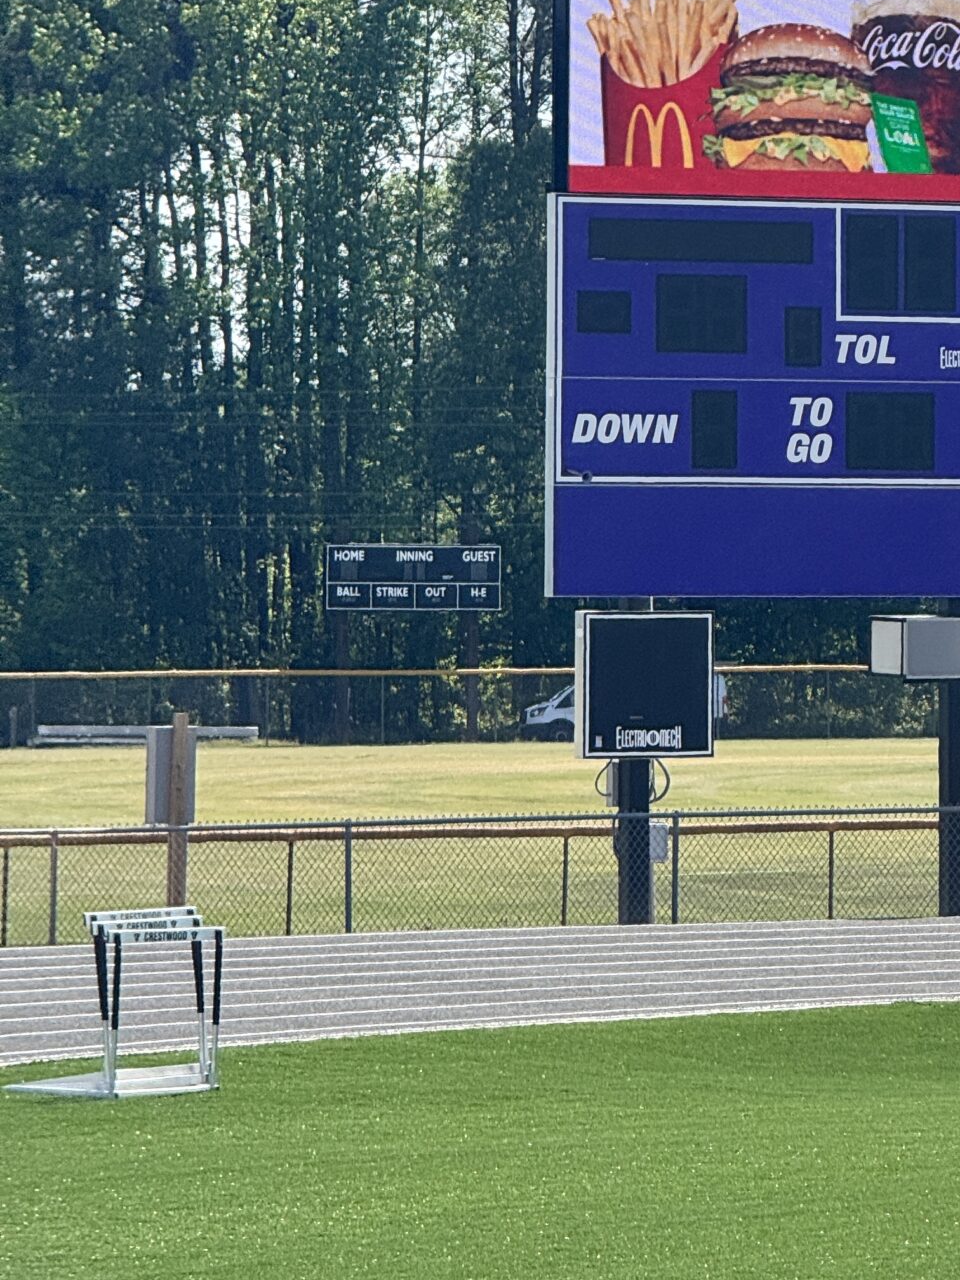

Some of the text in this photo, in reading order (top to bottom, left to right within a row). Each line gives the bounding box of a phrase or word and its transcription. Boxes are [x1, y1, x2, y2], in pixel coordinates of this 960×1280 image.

[834, 334, 897, 365] TOL
[788, 397, 834, 428] TO
[571, 413, 679, 445] DOWN
[785, 433, 833, 464] GO
[333, 550, 366, 562] HOME
[395, 550, 434, 563] INNING
[462, 550, 497, 563] GUEST
[336, 586, 361, 598] BALL
[376, 586, 409, 598] STRIKE
[424, 586, 447, 598] OUT
[143, 930, 188, 942] CRESTWOOD
